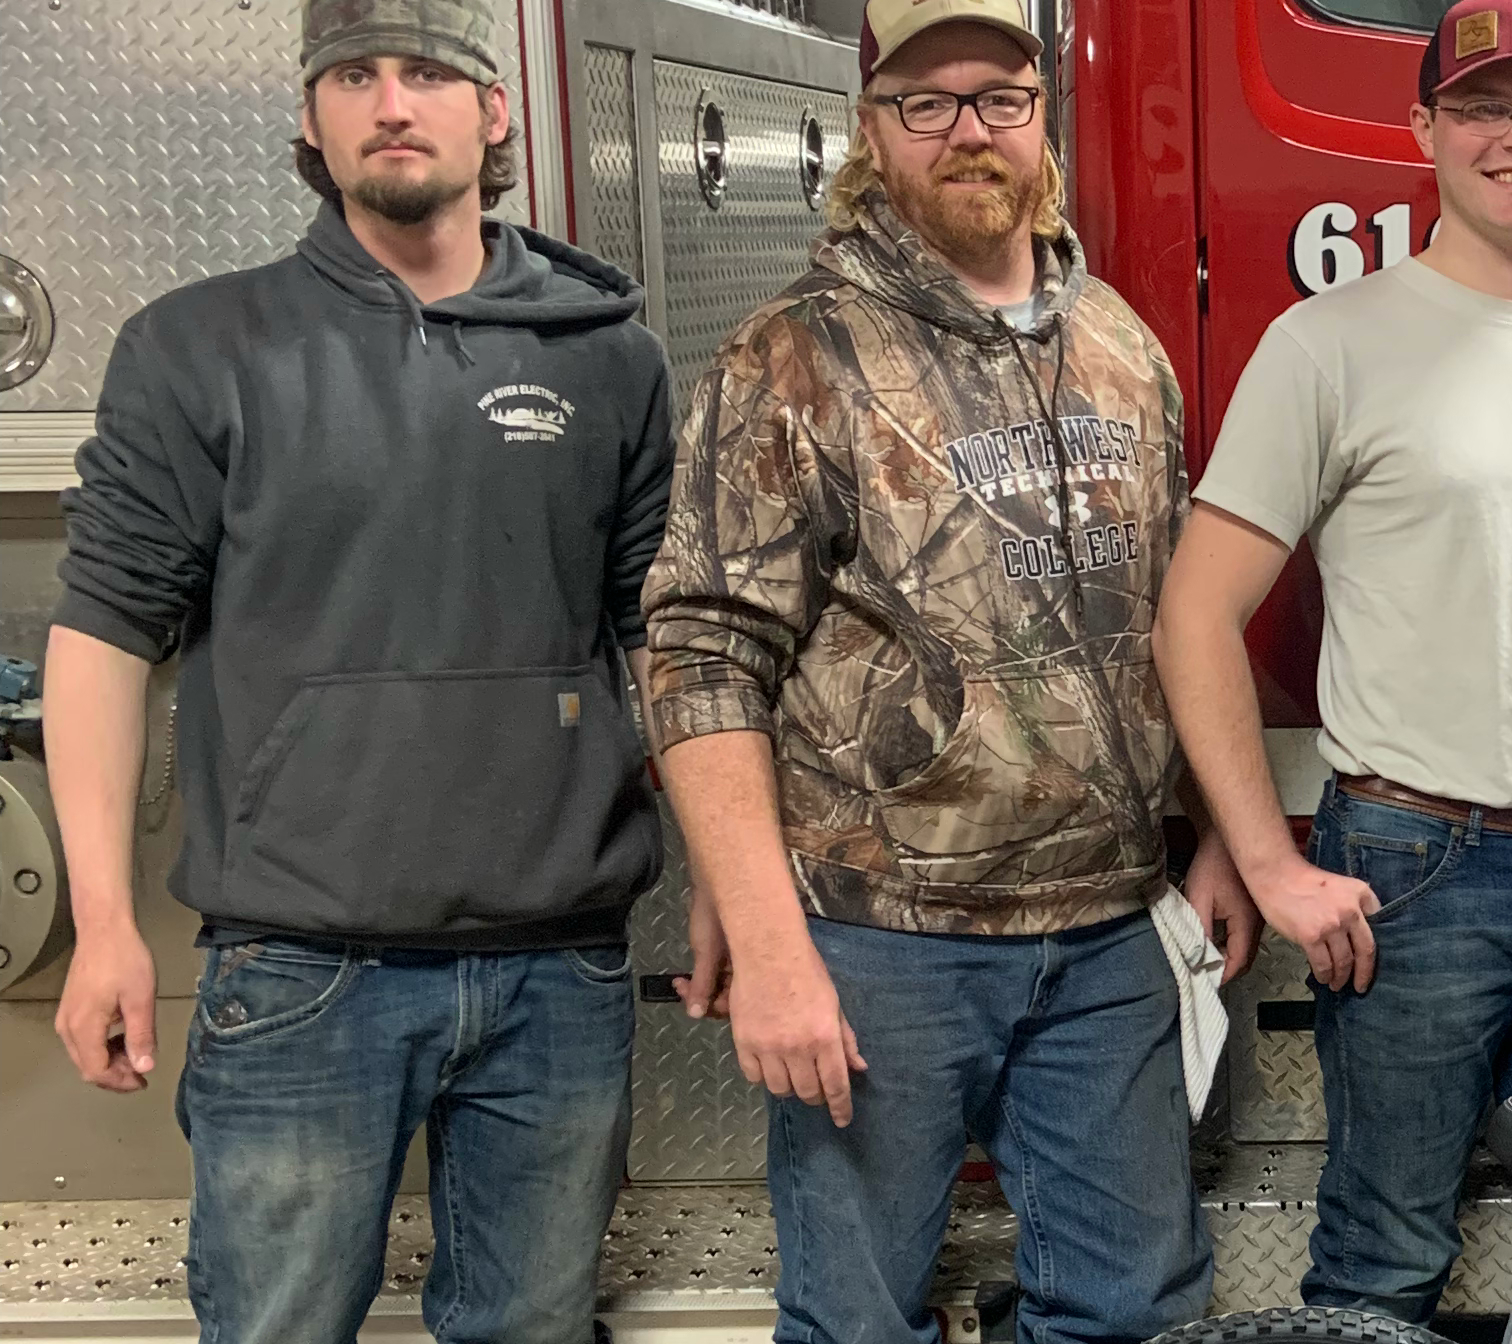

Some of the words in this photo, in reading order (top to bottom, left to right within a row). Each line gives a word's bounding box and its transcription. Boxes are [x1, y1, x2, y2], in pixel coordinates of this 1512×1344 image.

[1288, 202, 1441, 297] 61
[945, 415, 1143, 492] NORTHWEST
[1000, 520, 1139, 580] COLLEGE
